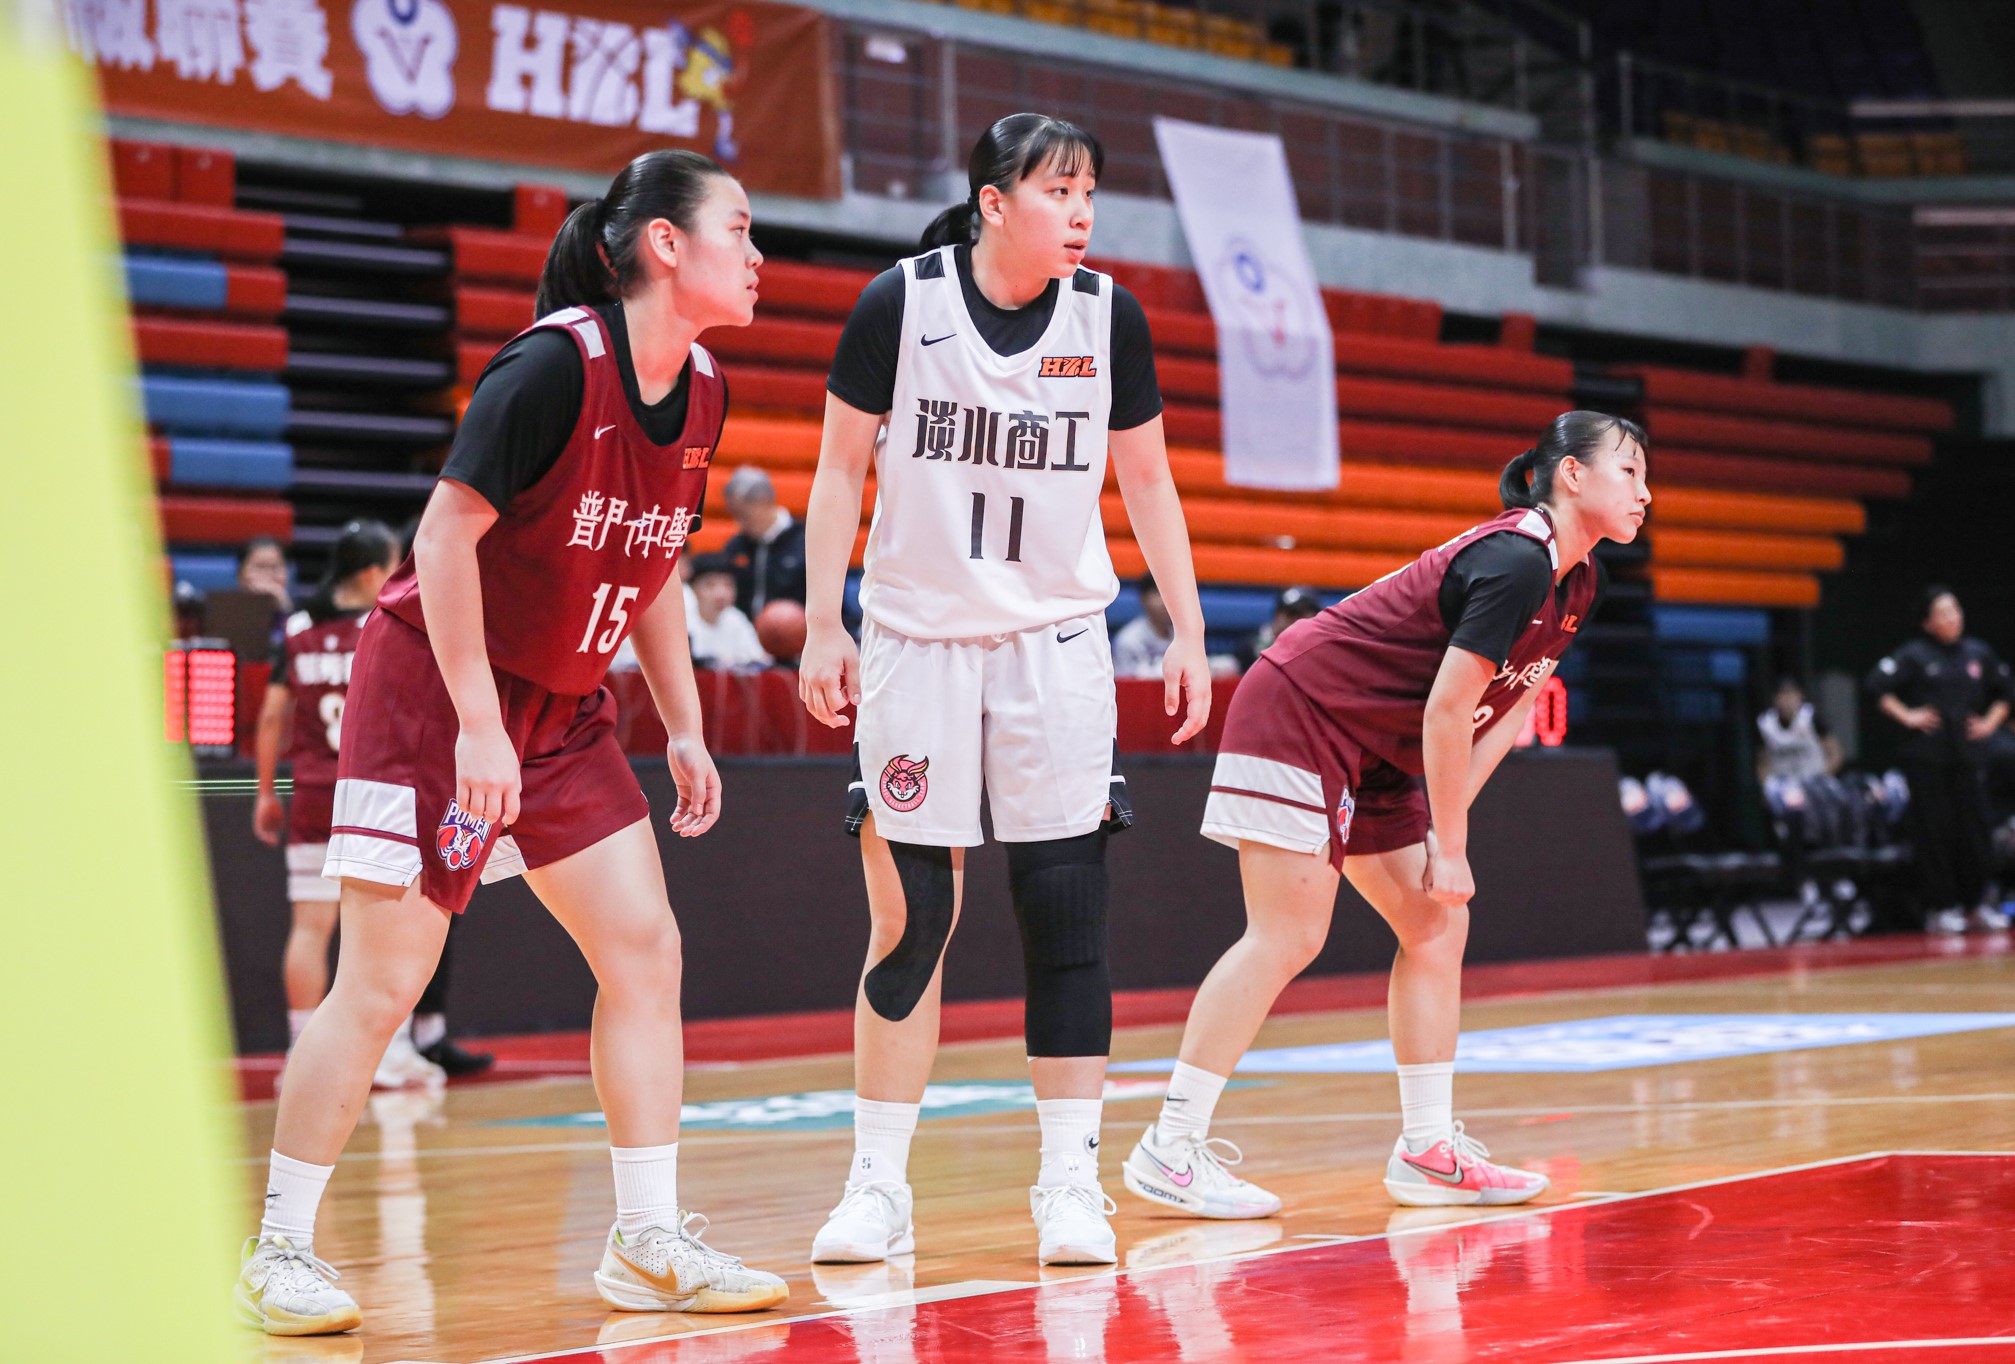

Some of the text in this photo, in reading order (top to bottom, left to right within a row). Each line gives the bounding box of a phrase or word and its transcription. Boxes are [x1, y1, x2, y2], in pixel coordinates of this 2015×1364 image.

[487, 7, 700, 138] HBL
[1039, 356, 1097, 377] HBL
[912, 398, 1091, 472] 淡水商工
[566, 489, 697, 559] 普門中學
[969, 492, 1024, 562] 11
[576, 582, 640, 654] 15
[889, 797, 920, 809] BASKETBALL
